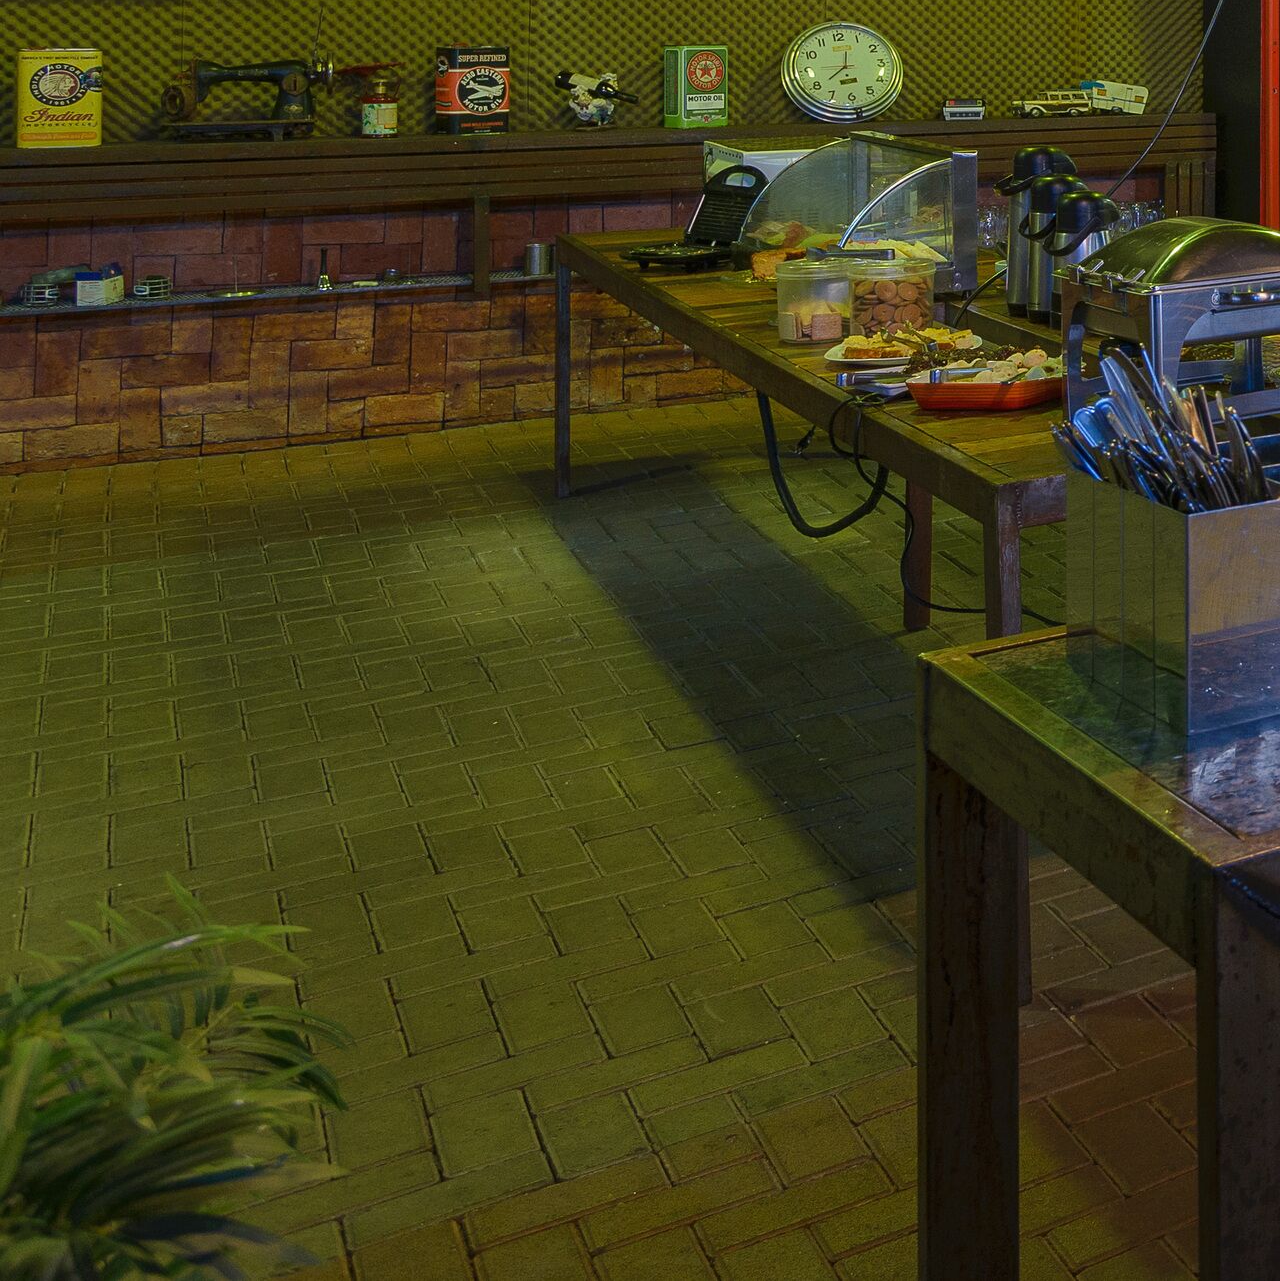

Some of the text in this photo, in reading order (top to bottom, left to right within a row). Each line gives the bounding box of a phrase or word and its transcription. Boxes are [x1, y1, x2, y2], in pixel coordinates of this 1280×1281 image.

[832, 32, 844, 42] 12
[817, 38, 826, 47] 11
[868, 44, 878, 53] 2
[457, 54, 507, 63] SUPER REFINED
[805, 50, 818, 60] 10
[877, 58, 886, 68] 3
[460, 68, 505, 86] AERO EASTERN
[812, 81, 822, 90] 8
[866, 86, 875, 95] 5
[847, 92, 857, 102] 6
[463, 98, 503, 112] MOTOR OIL
[23, 107, 94, 123] Indian
